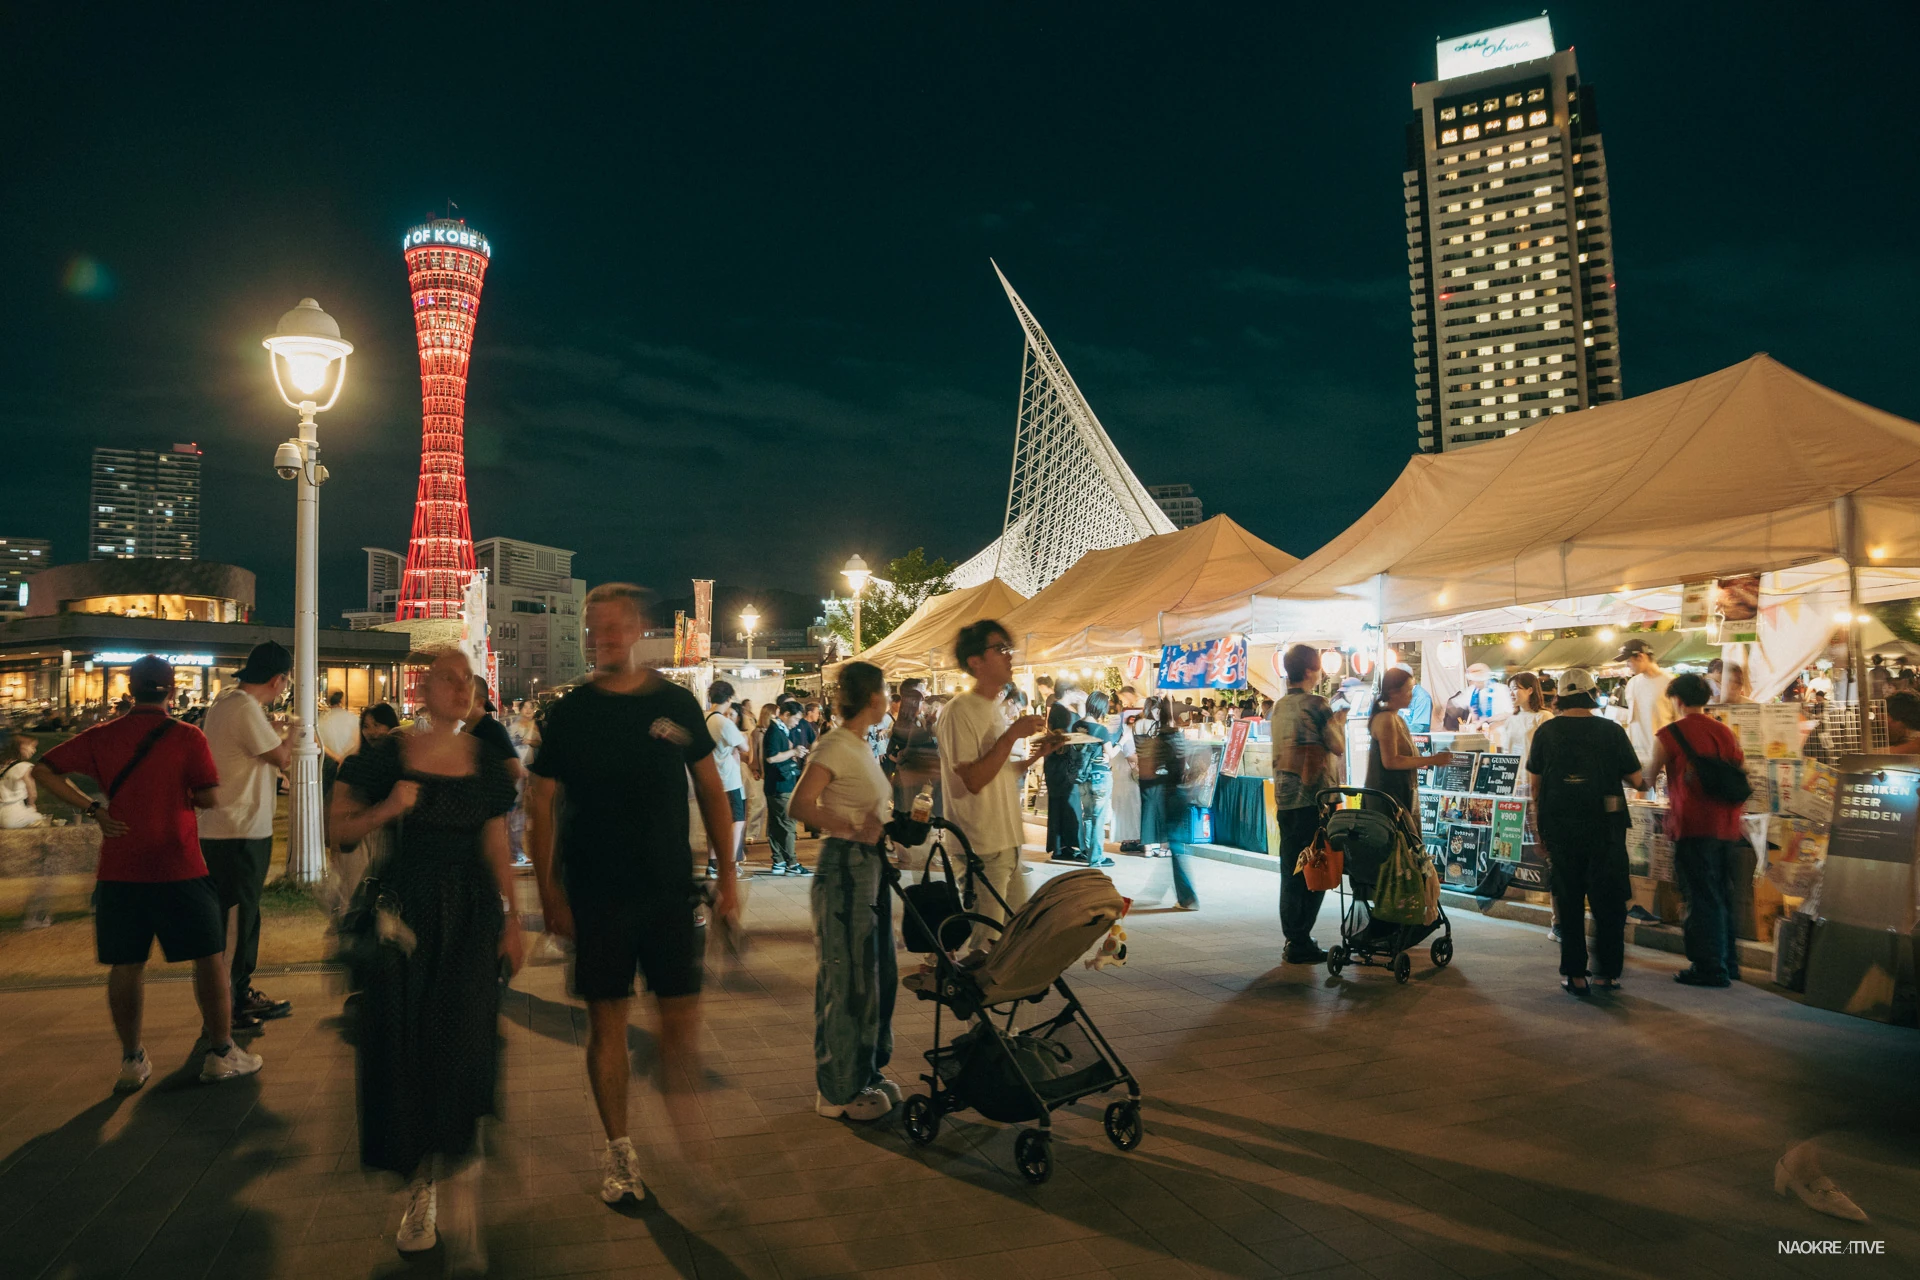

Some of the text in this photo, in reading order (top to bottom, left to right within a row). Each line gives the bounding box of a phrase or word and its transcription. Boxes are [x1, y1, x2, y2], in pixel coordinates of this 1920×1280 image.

[1482, 38, 1530, 57] Okura
[412, 229, 431, 243] OF
[434, 229, 477, 247] KOBE
[1501, 771, 1515, 780] ¥700
[1843, 784, 1910, 796] MERIKEN
[1841, 796, 1881, 807] BEER
[1500, 812, 1517, 821] ¥900
[1839, 808, 1902, 821] GARDEN
[1463, 842, 1476, 850] ¥500
[1462, 868, 1474, 876] ¥500
